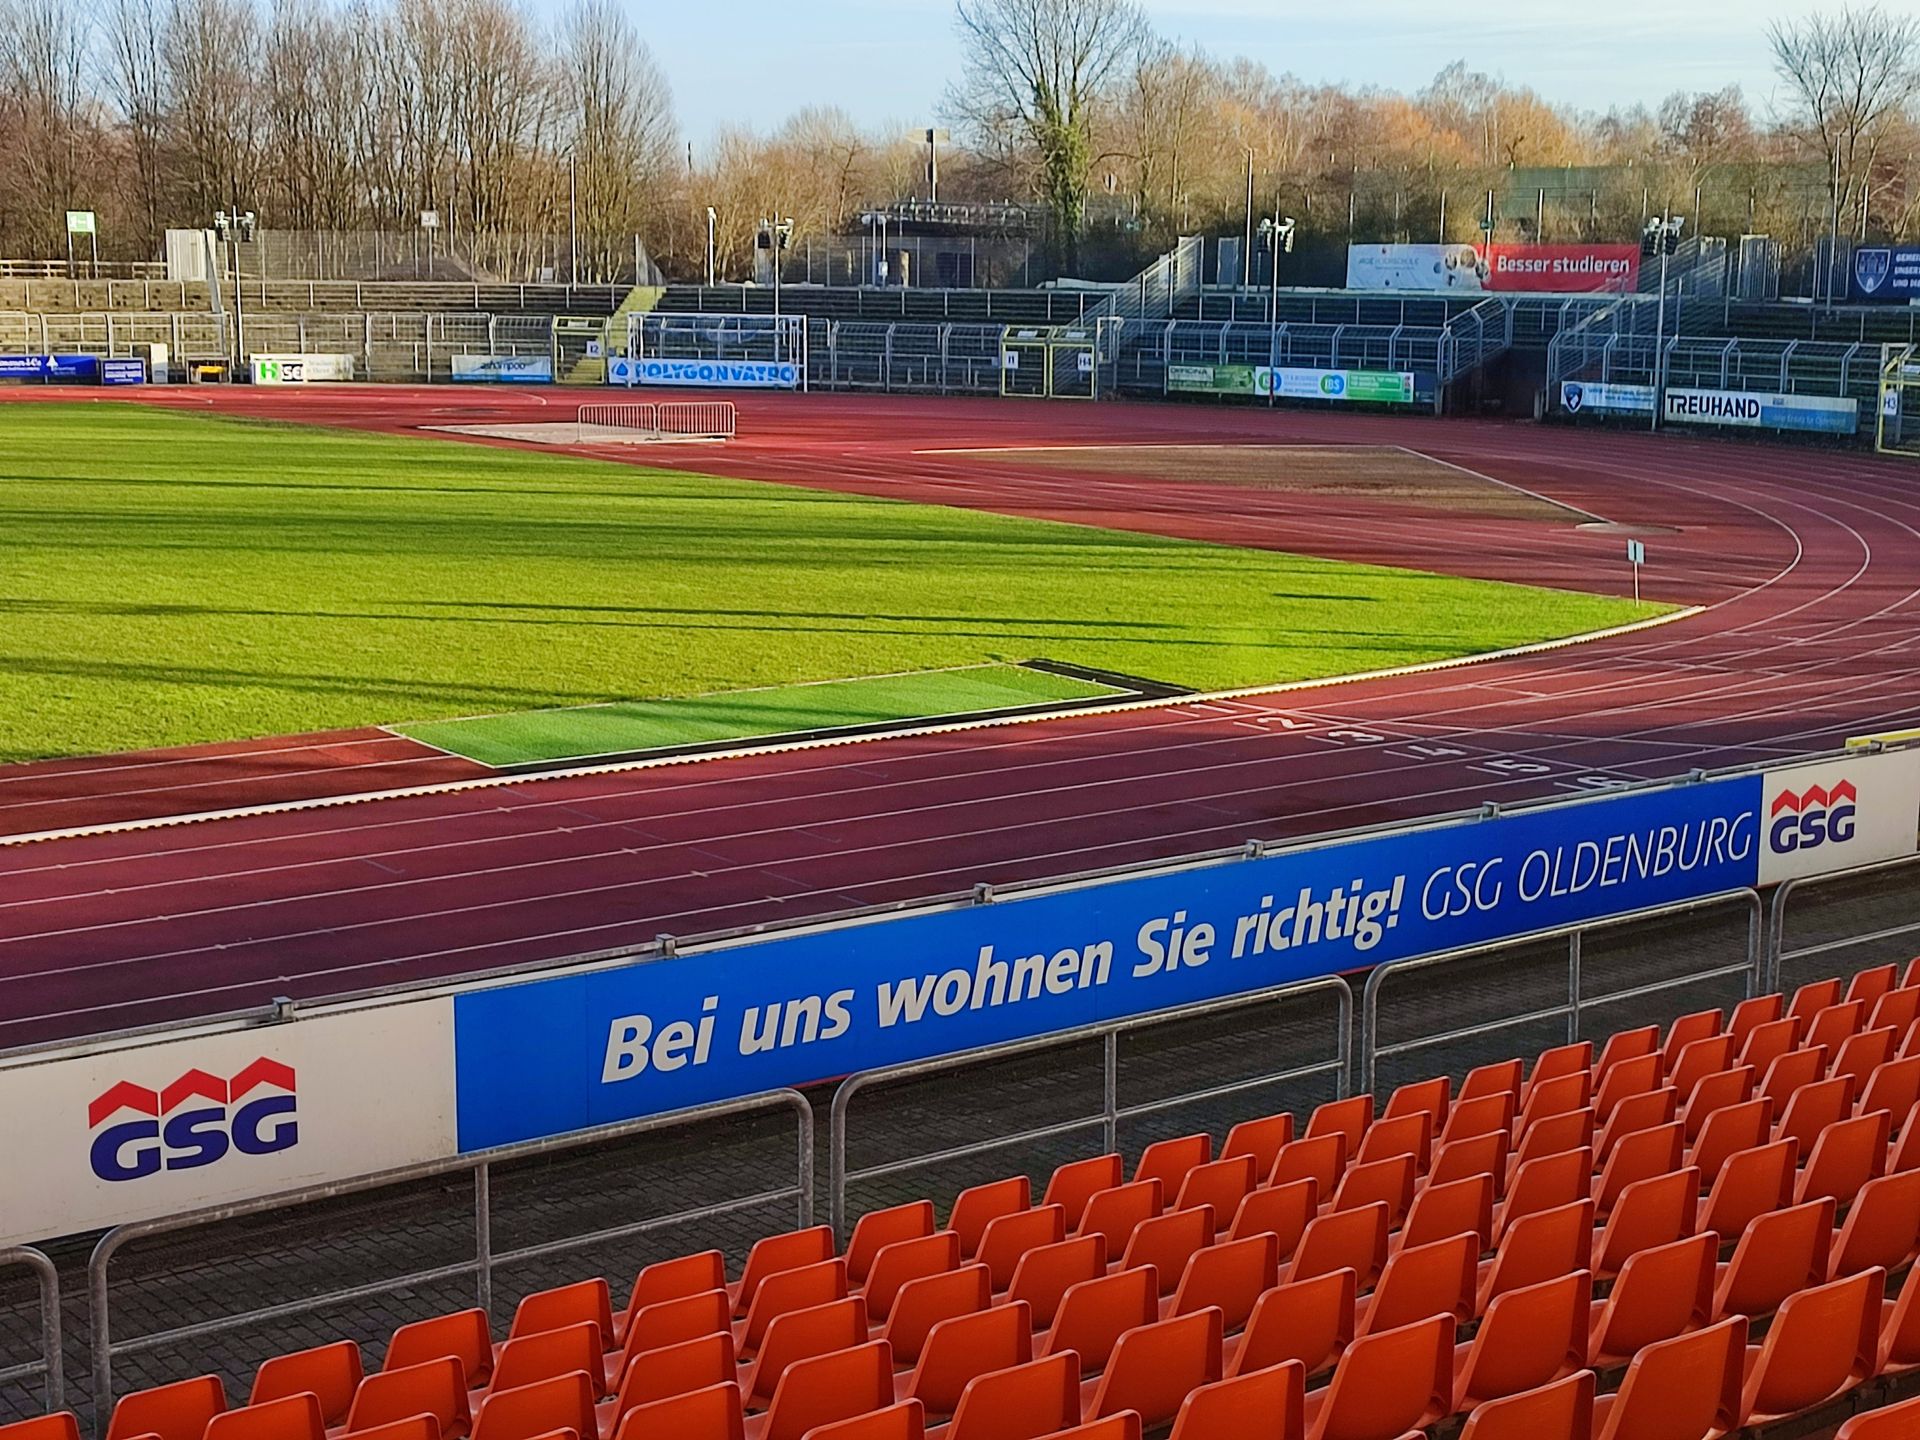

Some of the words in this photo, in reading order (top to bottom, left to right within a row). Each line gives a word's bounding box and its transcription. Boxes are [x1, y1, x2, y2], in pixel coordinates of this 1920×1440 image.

[1497, 255, 1551, 273] Besser
[1553, 255, 1630, 274] studieren
[1667, 393, 1760, 419] TREUHAND
[1884, 396, 1897, 410] H3
[1257, 716, 1315, 730] 2
[1328, 729, 1385, 743] 3
[1410, 743, 1468, 758] 4
[1485, 758, 1551, 774] 5
[1769, 804, 1856, 855] GSG
[601, 995, 719, 1085] Bei
[739, 989, 855, 1057] uns
[877, 945, 1115, 1029] wohnen
[1132, 909, 1216, 978] Sie
[1231, 875, 1405, 952] richtig!
[1421, 857, 1504, 921] GSG
[1517, 811, 1753, 901] OLDENBURG
[89, 1094, 299, 1182] GSG
